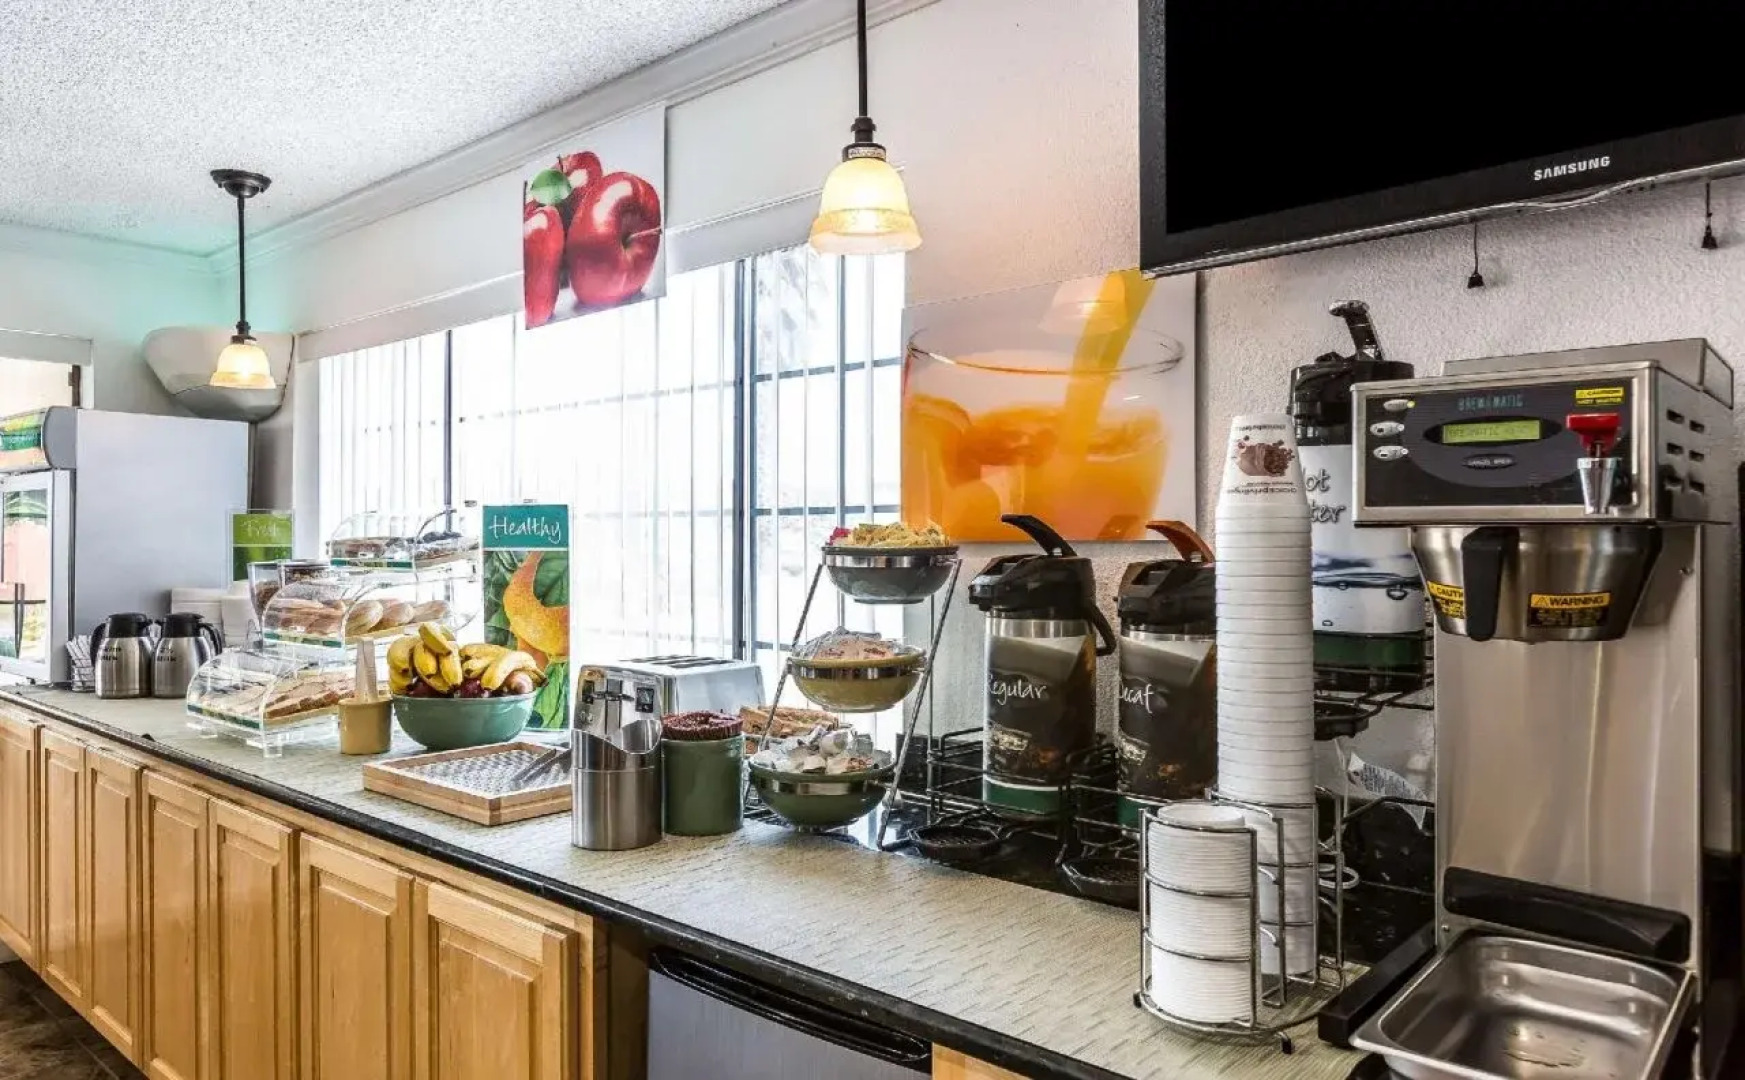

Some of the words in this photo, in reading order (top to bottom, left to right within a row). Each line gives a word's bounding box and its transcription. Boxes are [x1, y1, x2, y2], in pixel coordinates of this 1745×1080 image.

[1533, 156, 1610, 181] SAMSUNG
[1303, 468, 1331, 492] ot
[1310, 499, 1347, 523] ter
[488, 515, 561, 544] Healthy
[1550, 596, 1604, 606] WARNING
